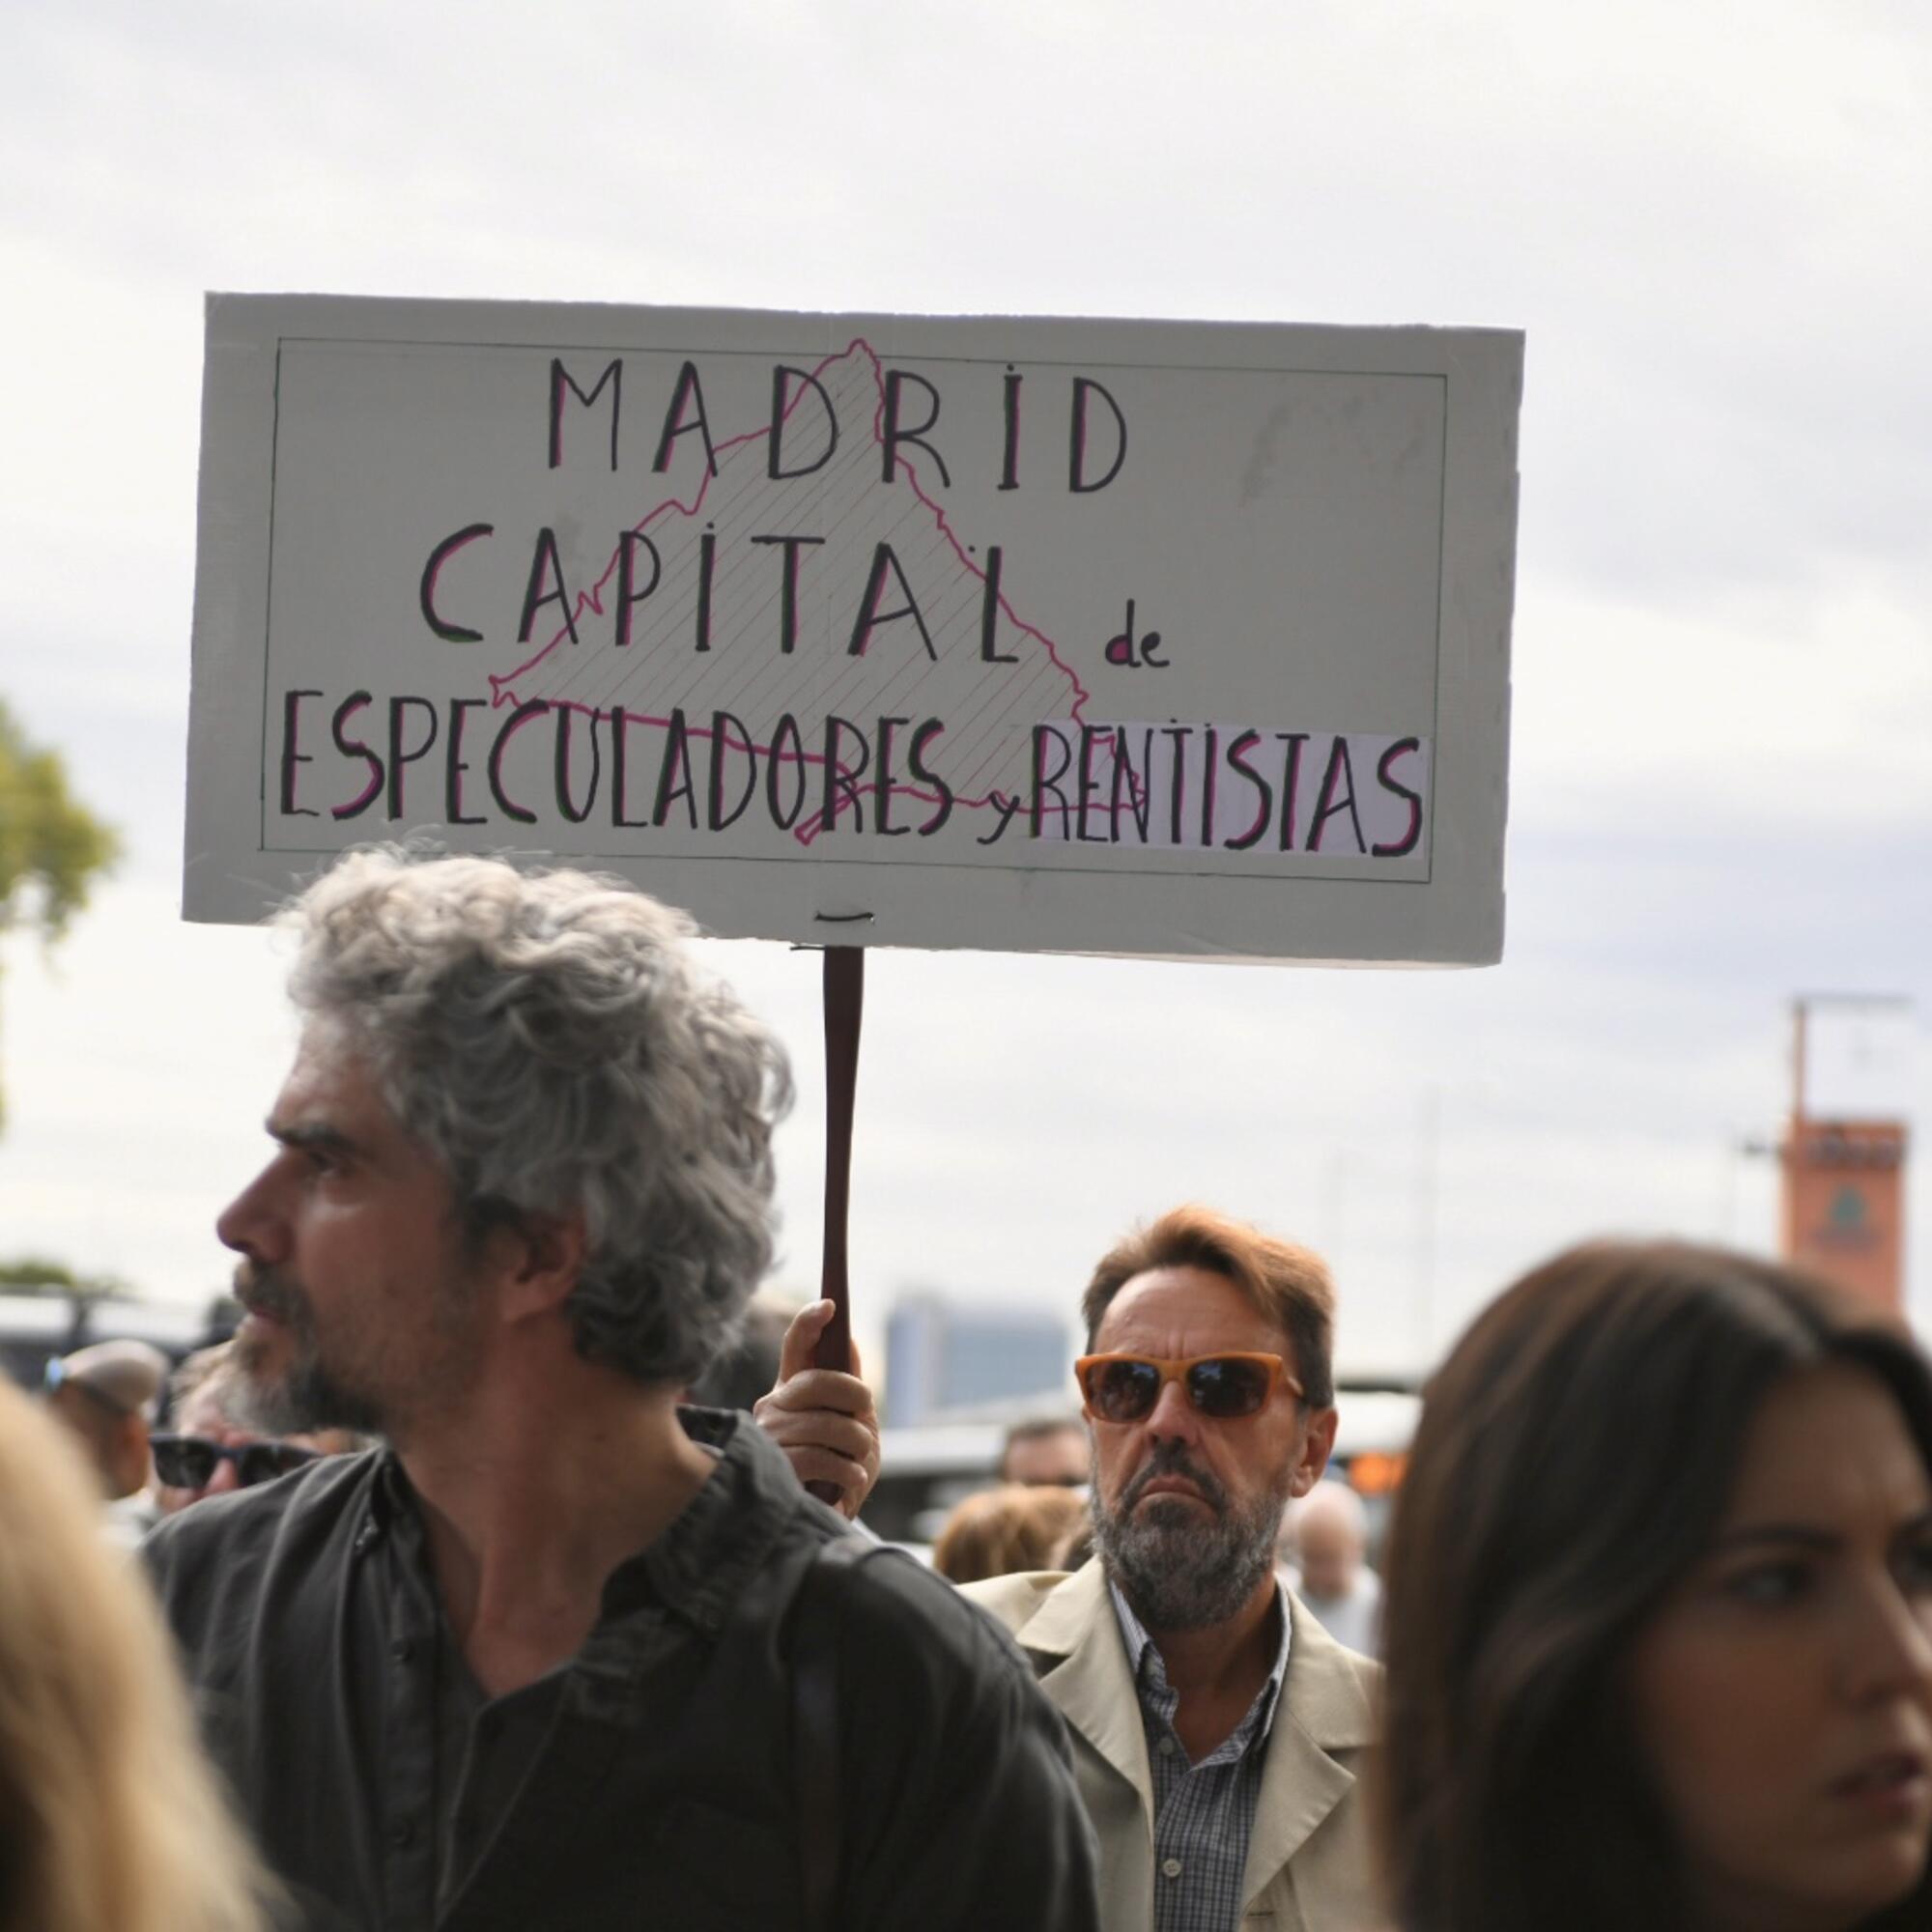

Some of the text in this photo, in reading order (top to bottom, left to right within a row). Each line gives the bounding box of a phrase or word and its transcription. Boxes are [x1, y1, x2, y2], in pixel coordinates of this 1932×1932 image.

[1104, 599, 1170, 669] de
[280, 690, 952, 837] ESPECULADORES
[977, 791, 1020, 845] y
